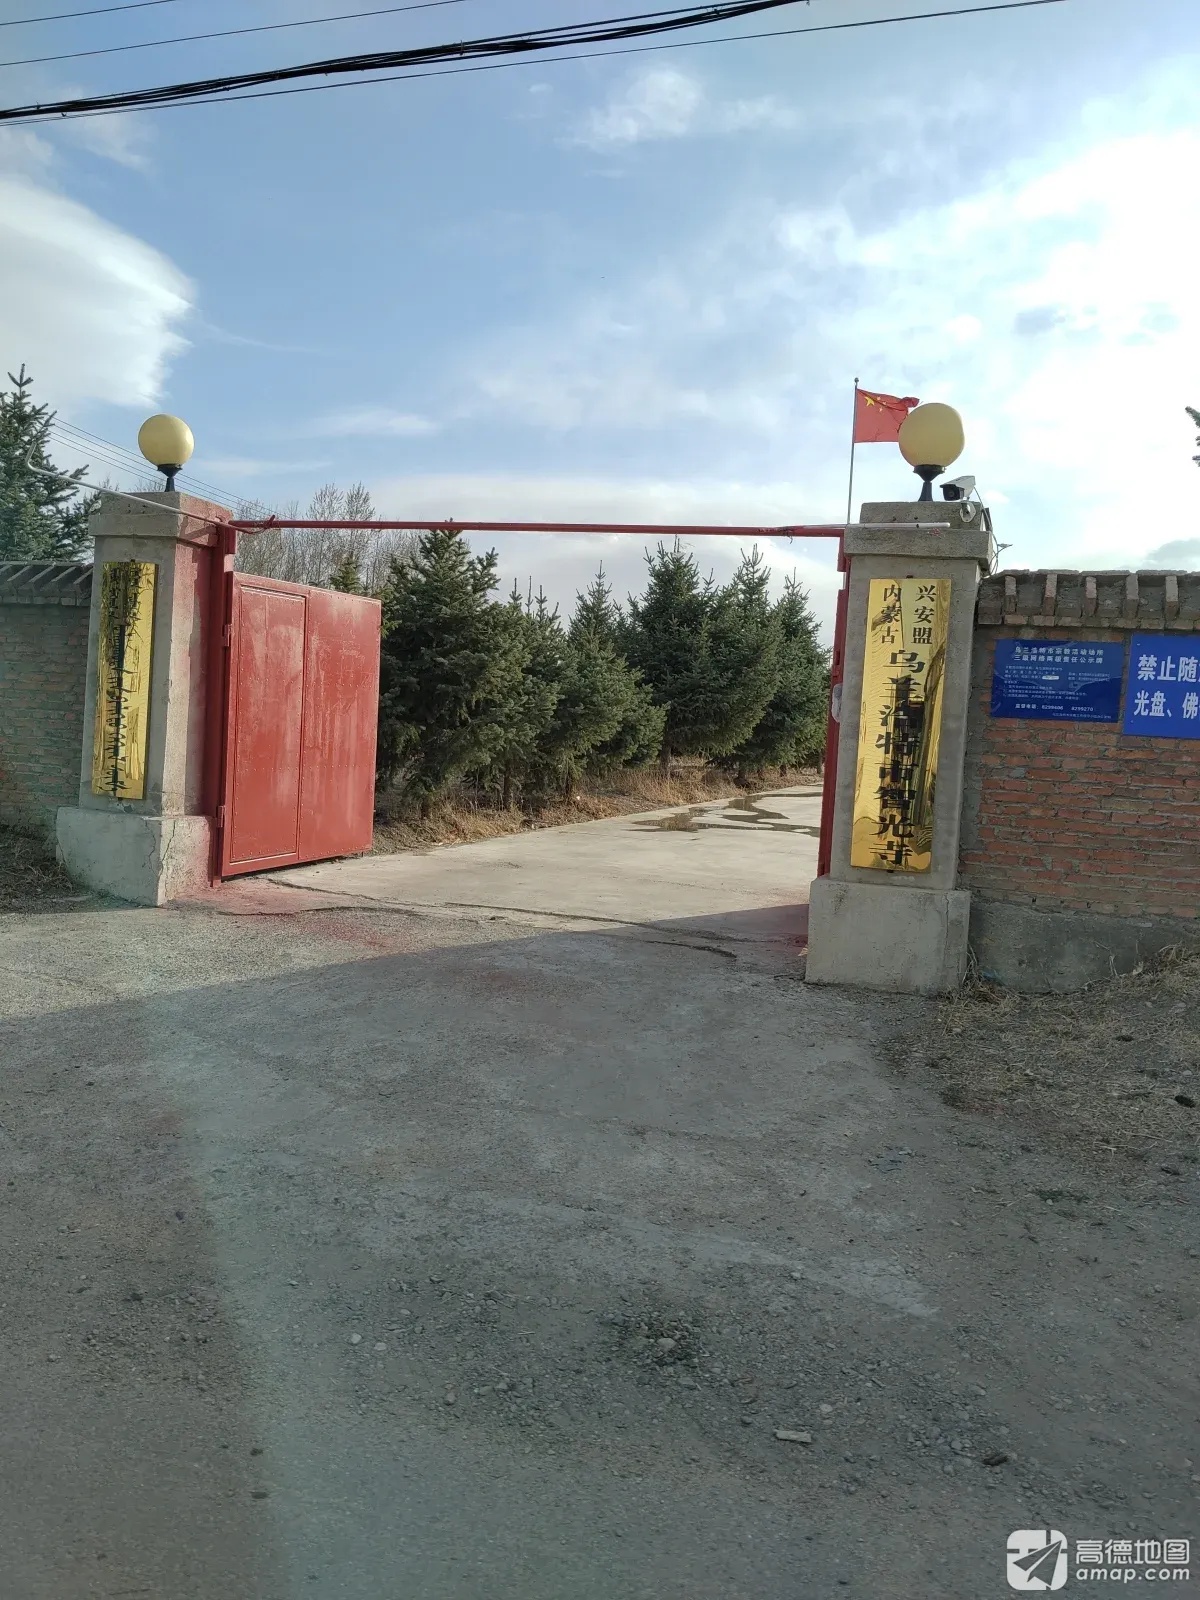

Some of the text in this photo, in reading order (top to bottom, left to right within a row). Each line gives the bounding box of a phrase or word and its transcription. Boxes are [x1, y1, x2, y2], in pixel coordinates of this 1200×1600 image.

[881, 585, 902, 645] 内蒙古
[911, 585, 937, 645] 兴安盟
[1137, 654, 1200, 682] 禁止随
[1133, 690, 1200, 719] 光盘、佛
